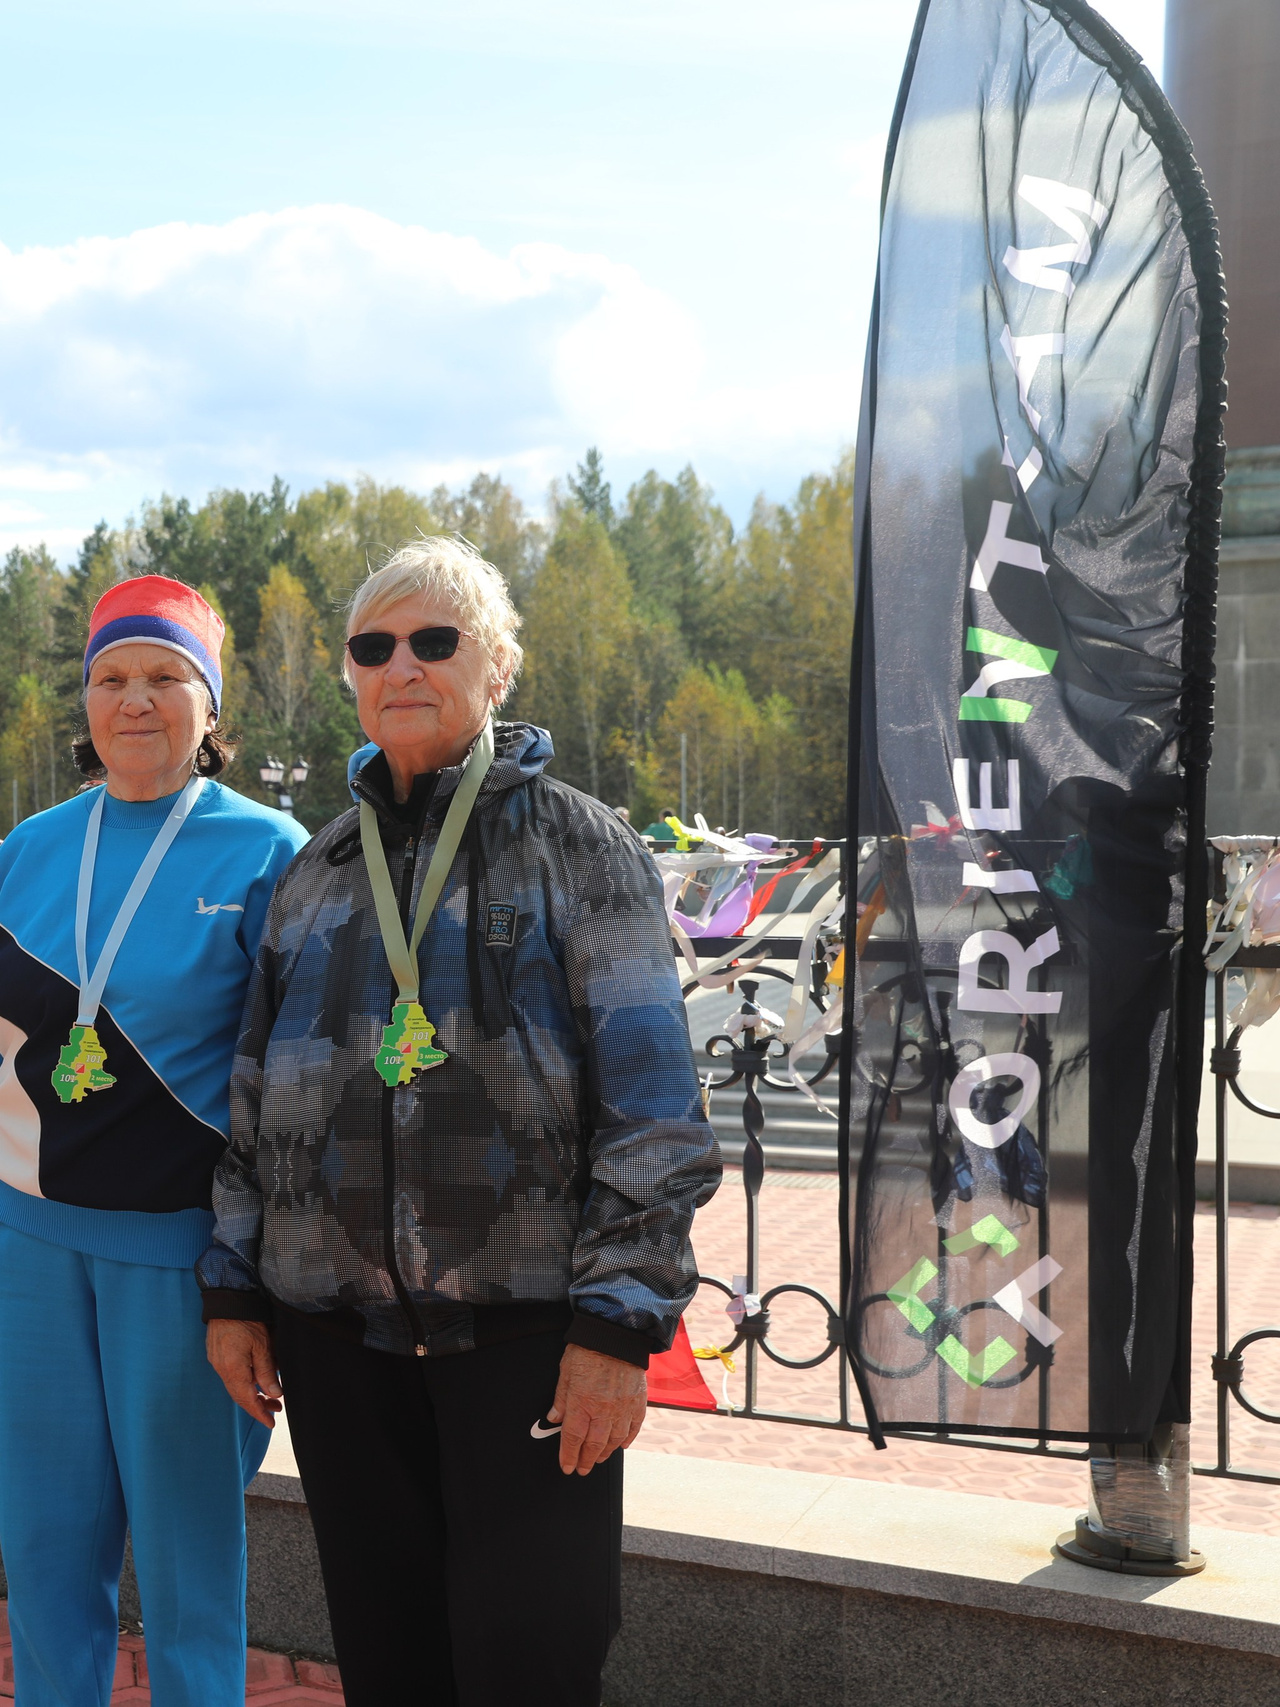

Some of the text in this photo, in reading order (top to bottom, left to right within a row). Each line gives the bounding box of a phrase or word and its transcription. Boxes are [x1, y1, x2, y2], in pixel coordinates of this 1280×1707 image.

[490, 926, 508, 934] PRO
[488, 933, 510, 942] DSGN
[411, 1031, 430, 1041] 101
[85, 1053, 102, 1064] 101
